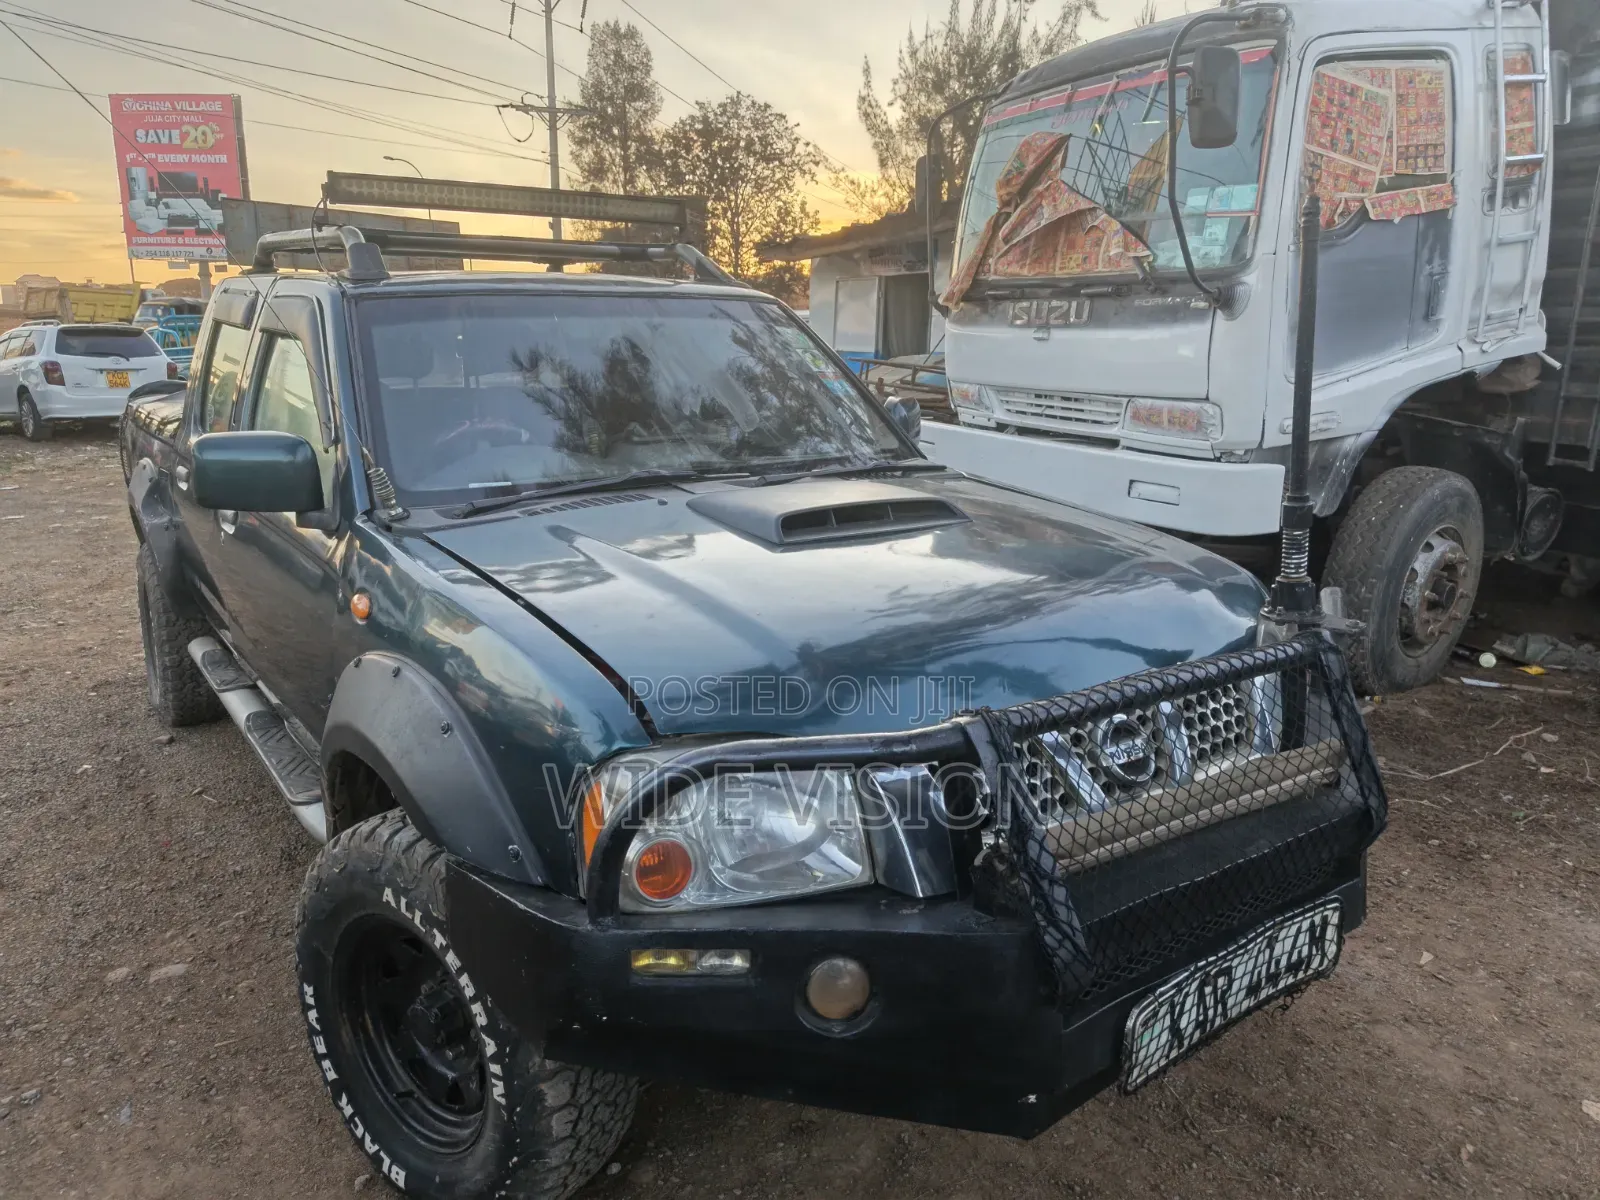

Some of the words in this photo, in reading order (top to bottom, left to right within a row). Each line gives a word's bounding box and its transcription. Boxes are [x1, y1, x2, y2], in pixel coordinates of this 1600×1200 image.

[174, 101, 222, 111] VILLAGE
[143, 115, 163, 123] JUJA
[164, 115, 181, 123] CITY
[183, 115, 204, 123] MALL
[135, 129, 181, 145] SAVE
[157, 154, 190, 163] EVERY
[191, 155, 227, 163] MONTH
[132, 236, 176, 244] FURNITURE
[1007, 299, 1092, 326] ISUZU
[382, 886, 426, 933] ALL
[432, 927, 506, 1106] TERRAIN
[303, 981, 340, 1082] BEAR
[338, 1092, 407, 1190] BLACK
